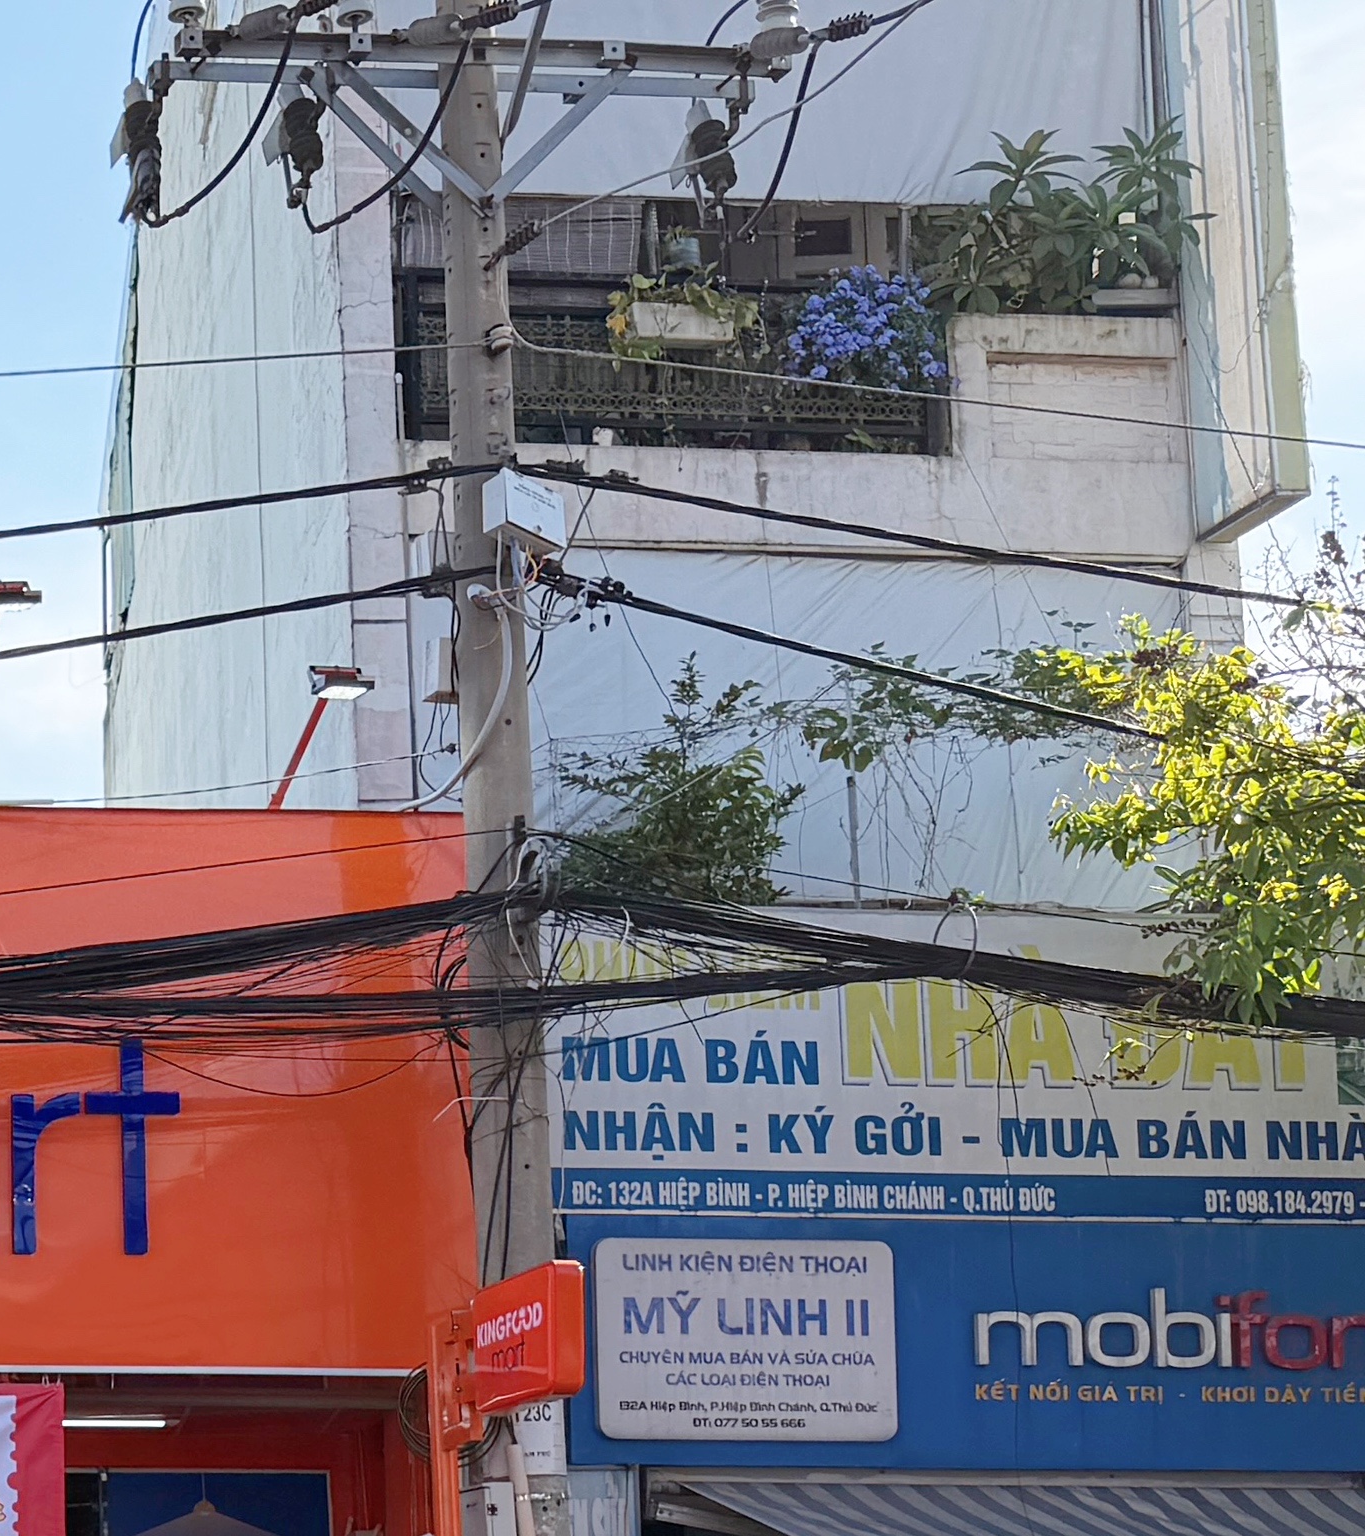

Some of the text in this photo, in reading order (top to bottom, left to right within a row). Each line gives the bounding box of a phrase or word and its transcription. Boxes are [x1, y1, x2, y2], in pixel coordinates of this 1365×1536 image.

[562, 1031, 819, 1086] MUA BÁN
[565, 1103, 714, 1160] NHẬN
[769, 1105, 833, 1154] KÝ
[855, 1102, 942, 1156] GỞI
[1001, 1118, 1119, 1159] MUA
[1137, 1111, 1247, 1160] BÁN
[572, 1181, 602, 1205] ĐC:
[608, 1181, 653, 1206] 132A
[664, 1177, 700, 1211] HIỆP
[706, 1178, 751, 1207] BÌNH
[769, 1185, 783, 1208] P.
[788, 1179, 829, 1213] HIỆP
[834, 1180, 879, 1209] BÌNH
[883, 1180, 946, 1211] CHÁNH
[1019, 1183, 1056, 1213] ĐỨC
[1205, 1189, 1356, 1215] ĐT: 098.184.2979
[622, 1251, 867, 1276] LINH KIỆN ĐIỆN THOẠI
[477, 1302, 543, 1348] KINGFOOD
[622, 1290, 869, 1337] MỸ LINH II
[492, 1334, 525, 1371] mart
[619, 1350, 684, 1366] CHUYÊN
[689, 1352, 726, 1365] MUA
[730, 1350, 764, 1365] BÁN
[769, 1350, 790, 1365] VÀ
[795, 1350, 828, 1366] SỬA
[666, 1372, 830, 1390] CÁC LOẠI ĐIỆN THOẠI
